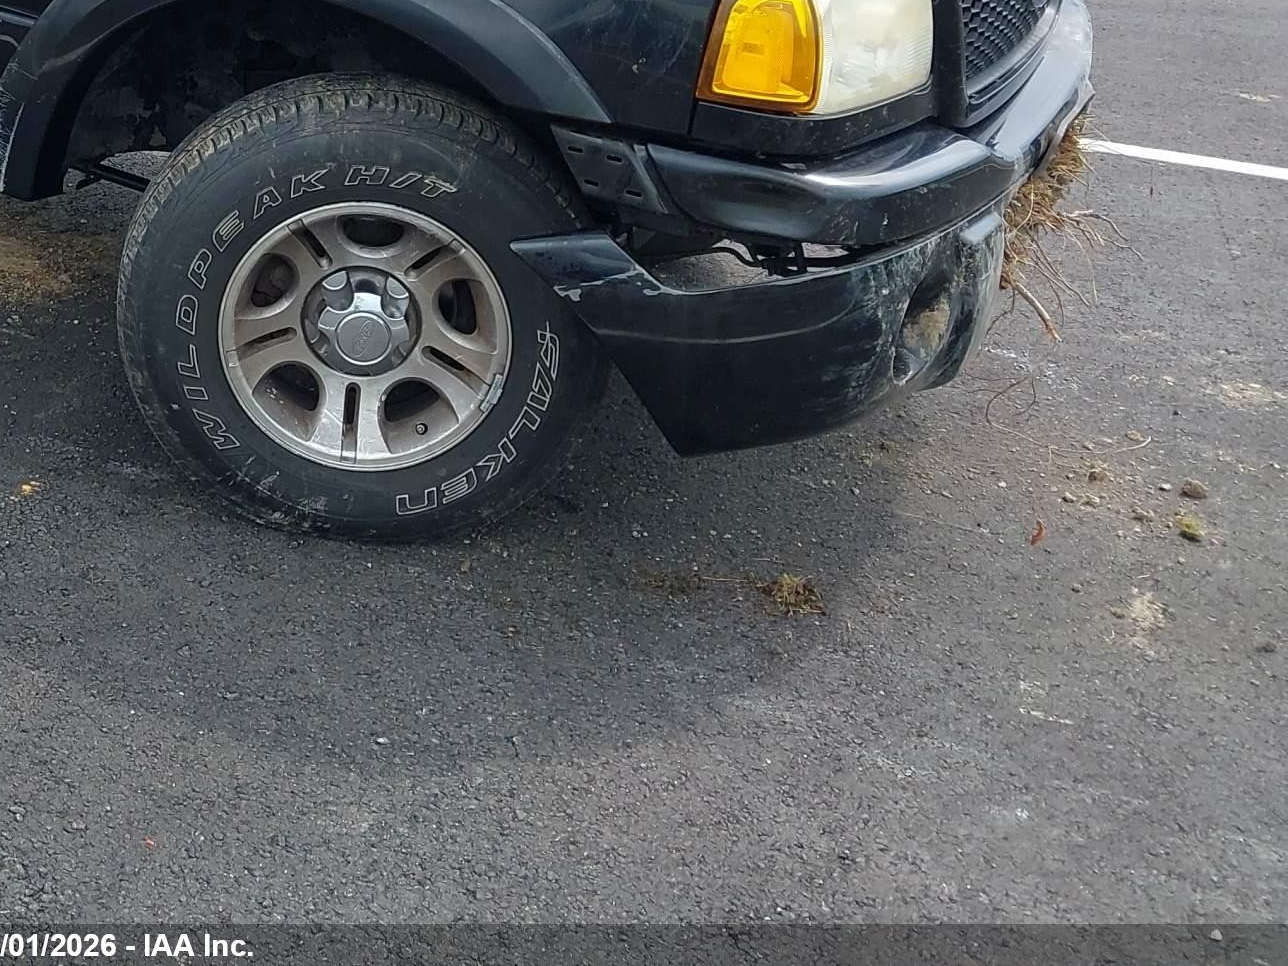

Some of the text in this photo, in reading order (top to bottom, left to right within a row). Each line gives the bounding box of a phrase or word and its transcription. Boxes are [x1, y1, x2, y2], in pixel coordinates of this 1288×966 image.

[175, 164, 458, 451] WILDPEAK H/T
[395, 320, 561, 516] FALKEN
